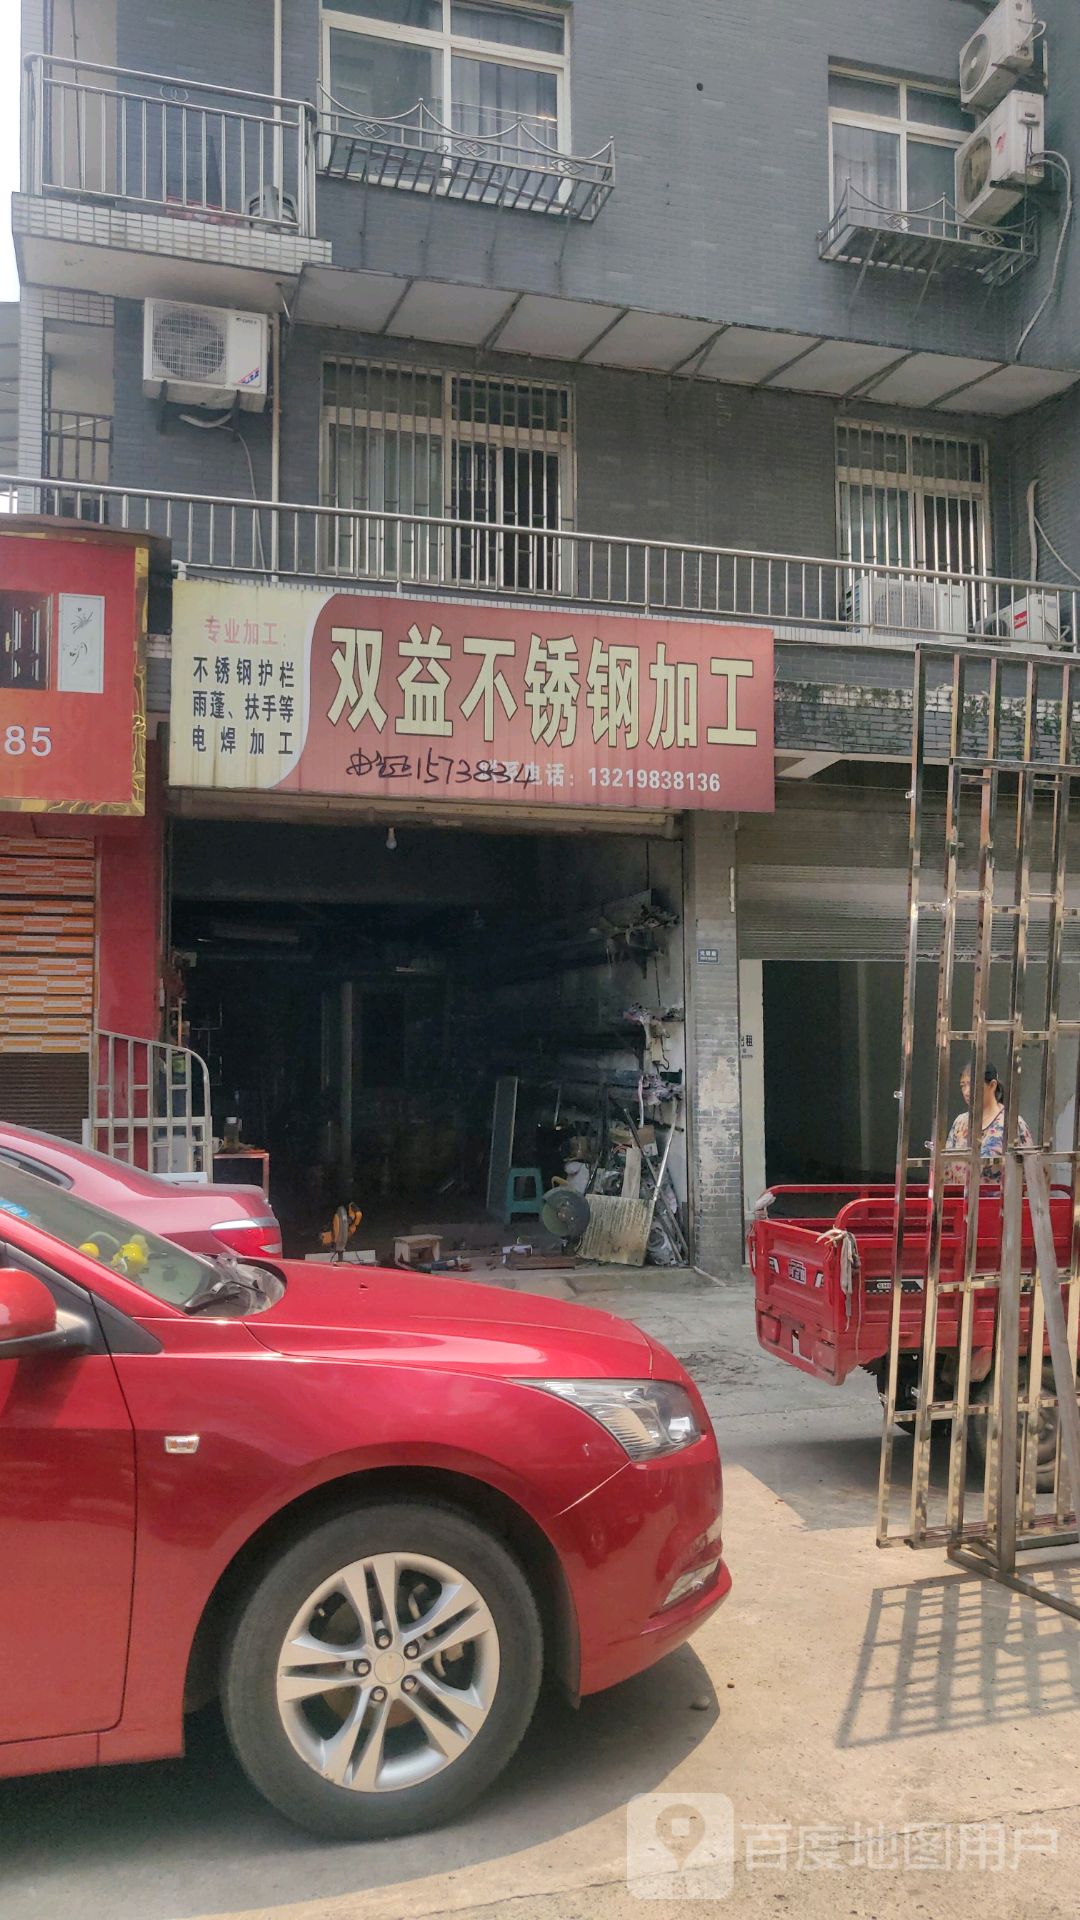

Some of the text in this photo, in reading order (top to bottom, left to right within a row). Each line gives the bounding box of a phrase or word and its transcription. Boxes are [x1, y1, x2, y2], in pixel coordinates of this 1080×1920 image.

[192, 656, 295, 689] 不锈钢护栏
[326, 622, 758, 750] 双益不锈钢加工
[192, 689, 295, 724] 雨蓬、扶手等
[4, 725, 53, 757] 85
[191, 724, 294, 756] 电焊加工
